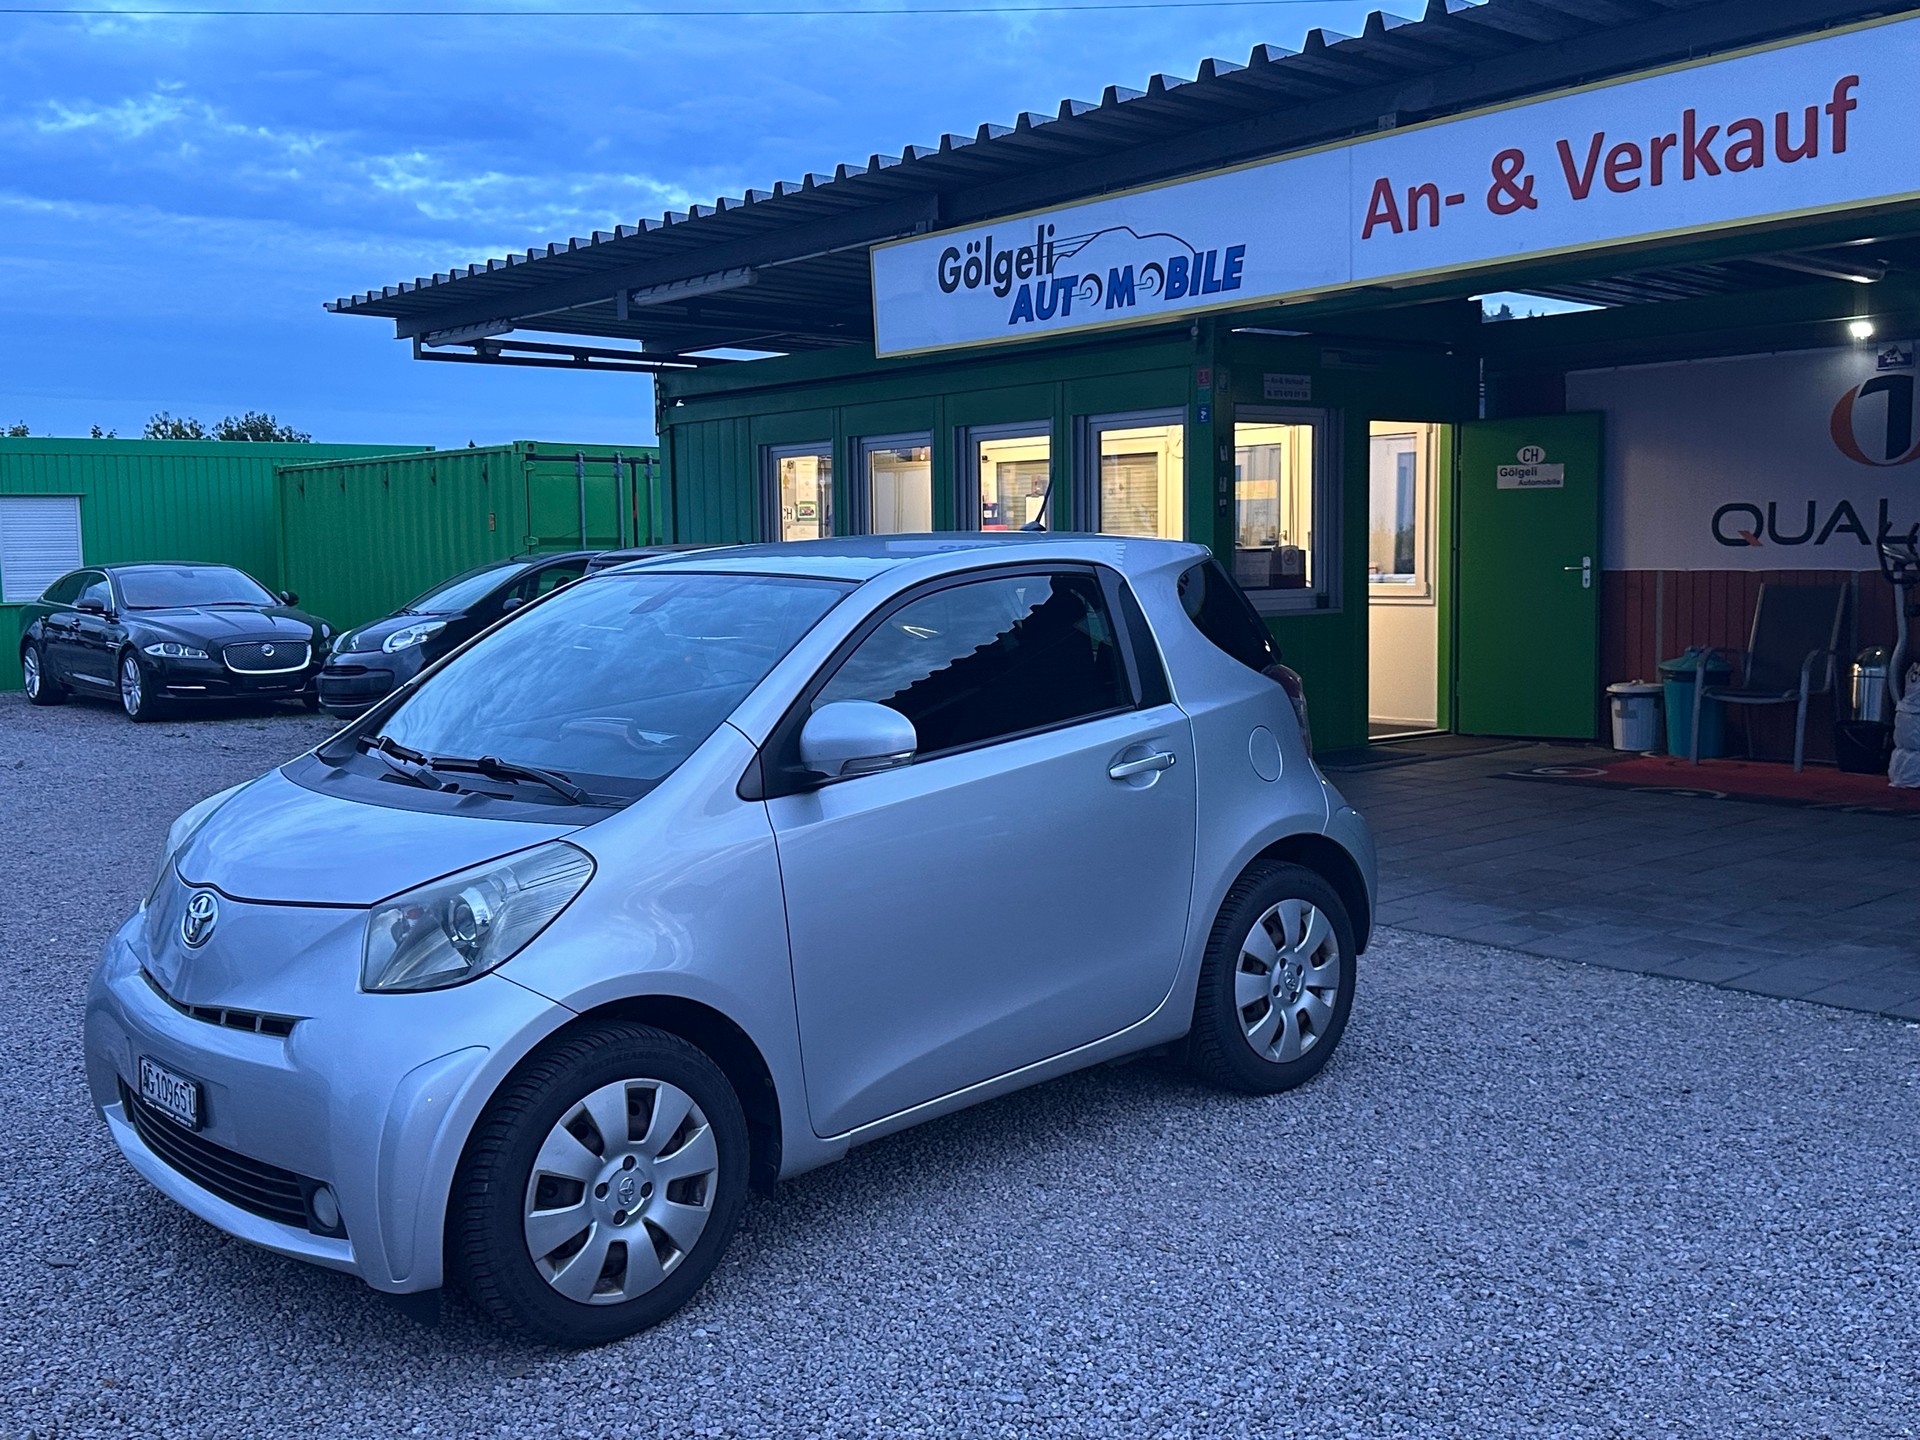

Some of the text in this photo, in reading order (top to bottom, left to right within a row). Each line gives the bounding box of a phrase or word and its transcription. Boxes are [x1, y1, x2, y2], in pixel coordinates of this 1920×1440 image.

[1361, 74, 1859, 240] An- & Verkauf
[937, 223, 1056, 298] Gölgeli
[1008, 243, 1247, 325] AUTOMOBILE
[1499, 467, 1538, 479] Gölgeli
[1522, 448, 1539, 462] CH
[1518, 479, 1561, 487] Automobile
